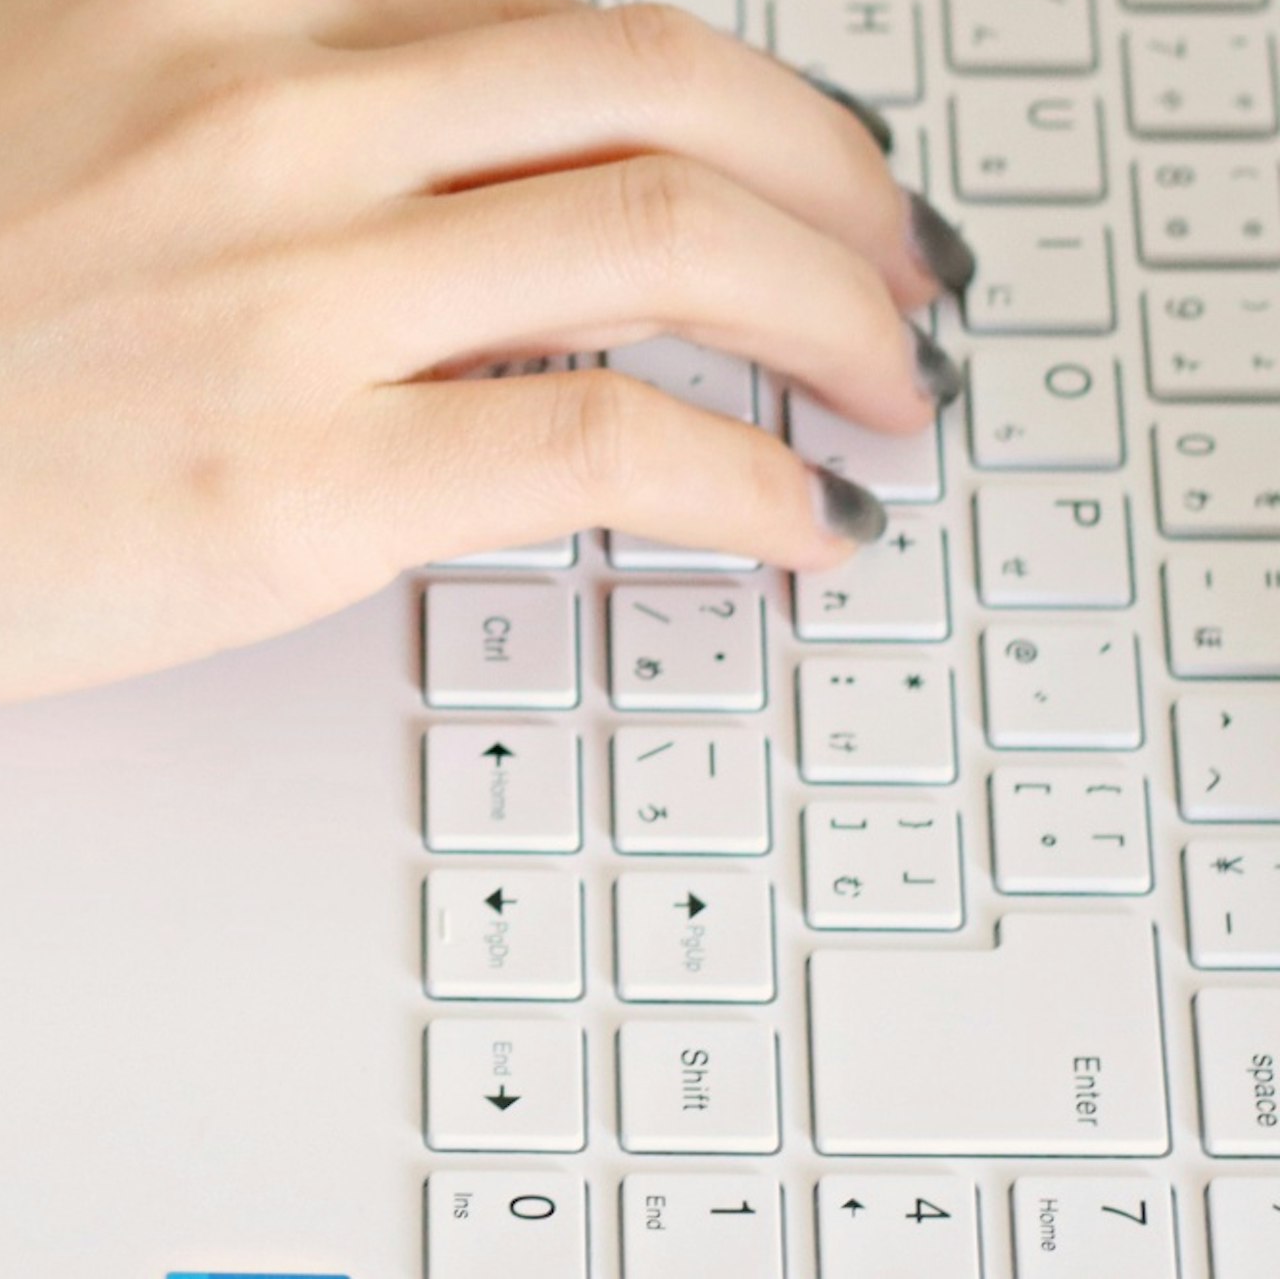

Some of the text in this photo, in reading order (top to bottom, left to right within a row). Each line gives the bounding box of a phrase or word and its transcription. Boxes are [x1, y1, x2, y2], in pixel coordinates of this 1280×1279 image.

[850, 2, 887, 34] H
[1152, 39, 1188, 60] 7
[1025, 98, 1073, 132] U
[1155, 165, 1196, 188] 8
[1164, 297, 1206, 321] 9
[1043, 362, 1094, 400] O
[1175, 433, 1217, 457] 0
[1055, 499, 1102, 528] P
[632, 601, 672, 625] /
[700, 600, 737, 619] ?
[481, 615, 512, 662] Ctrl
[1004, 639, 1039, 664] @
[636, 741, 674, 762] \
[489, 769, 508, 822] Home
[638, 805, 668, 823] ろ
[485, 920, 510, 970] PgDn
[681, 924, 707, 974] PgUp
[491, 1040, 514, 1077] End
[680, 1049, 710, 1111] Shift
[1072, 1056, 1102, 1126] Enter
[1247, 1054, 1279, 1128] space
[452, 1192, 473, 1220] Ins
[508, 1194, 557, 1221] 0
[645, 1194, 667, 1231] End
[710, 1200, 756, 1215] 1
[905, 1197, 951, 1224] 4
[1101, 1200, 1148, 1226] 7
[1038, 1198, 1058, 1252] Home
